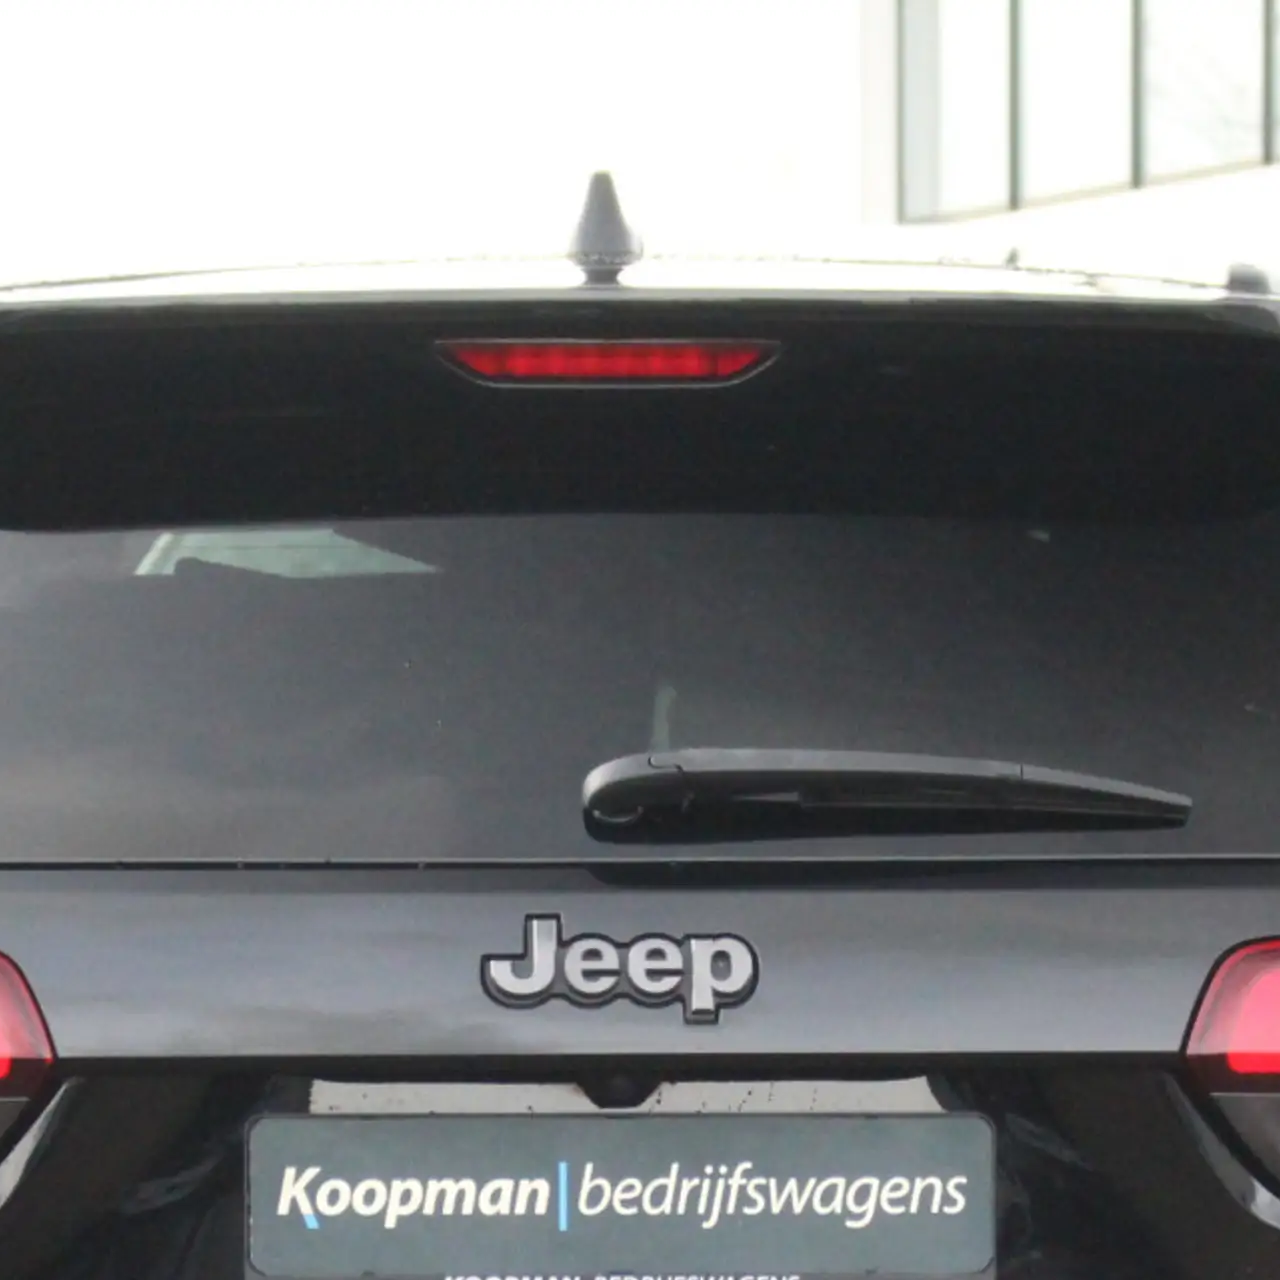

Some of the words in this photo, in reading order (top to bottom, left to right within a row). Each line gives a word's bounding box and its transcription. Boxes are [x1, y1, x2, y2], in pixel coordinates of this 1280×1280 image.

[484, 913, 759, 1024] Jeep
[277, 1166, 551, 1229] Koopman
[578, 1162, 968, 1229] bedrijfswagens
